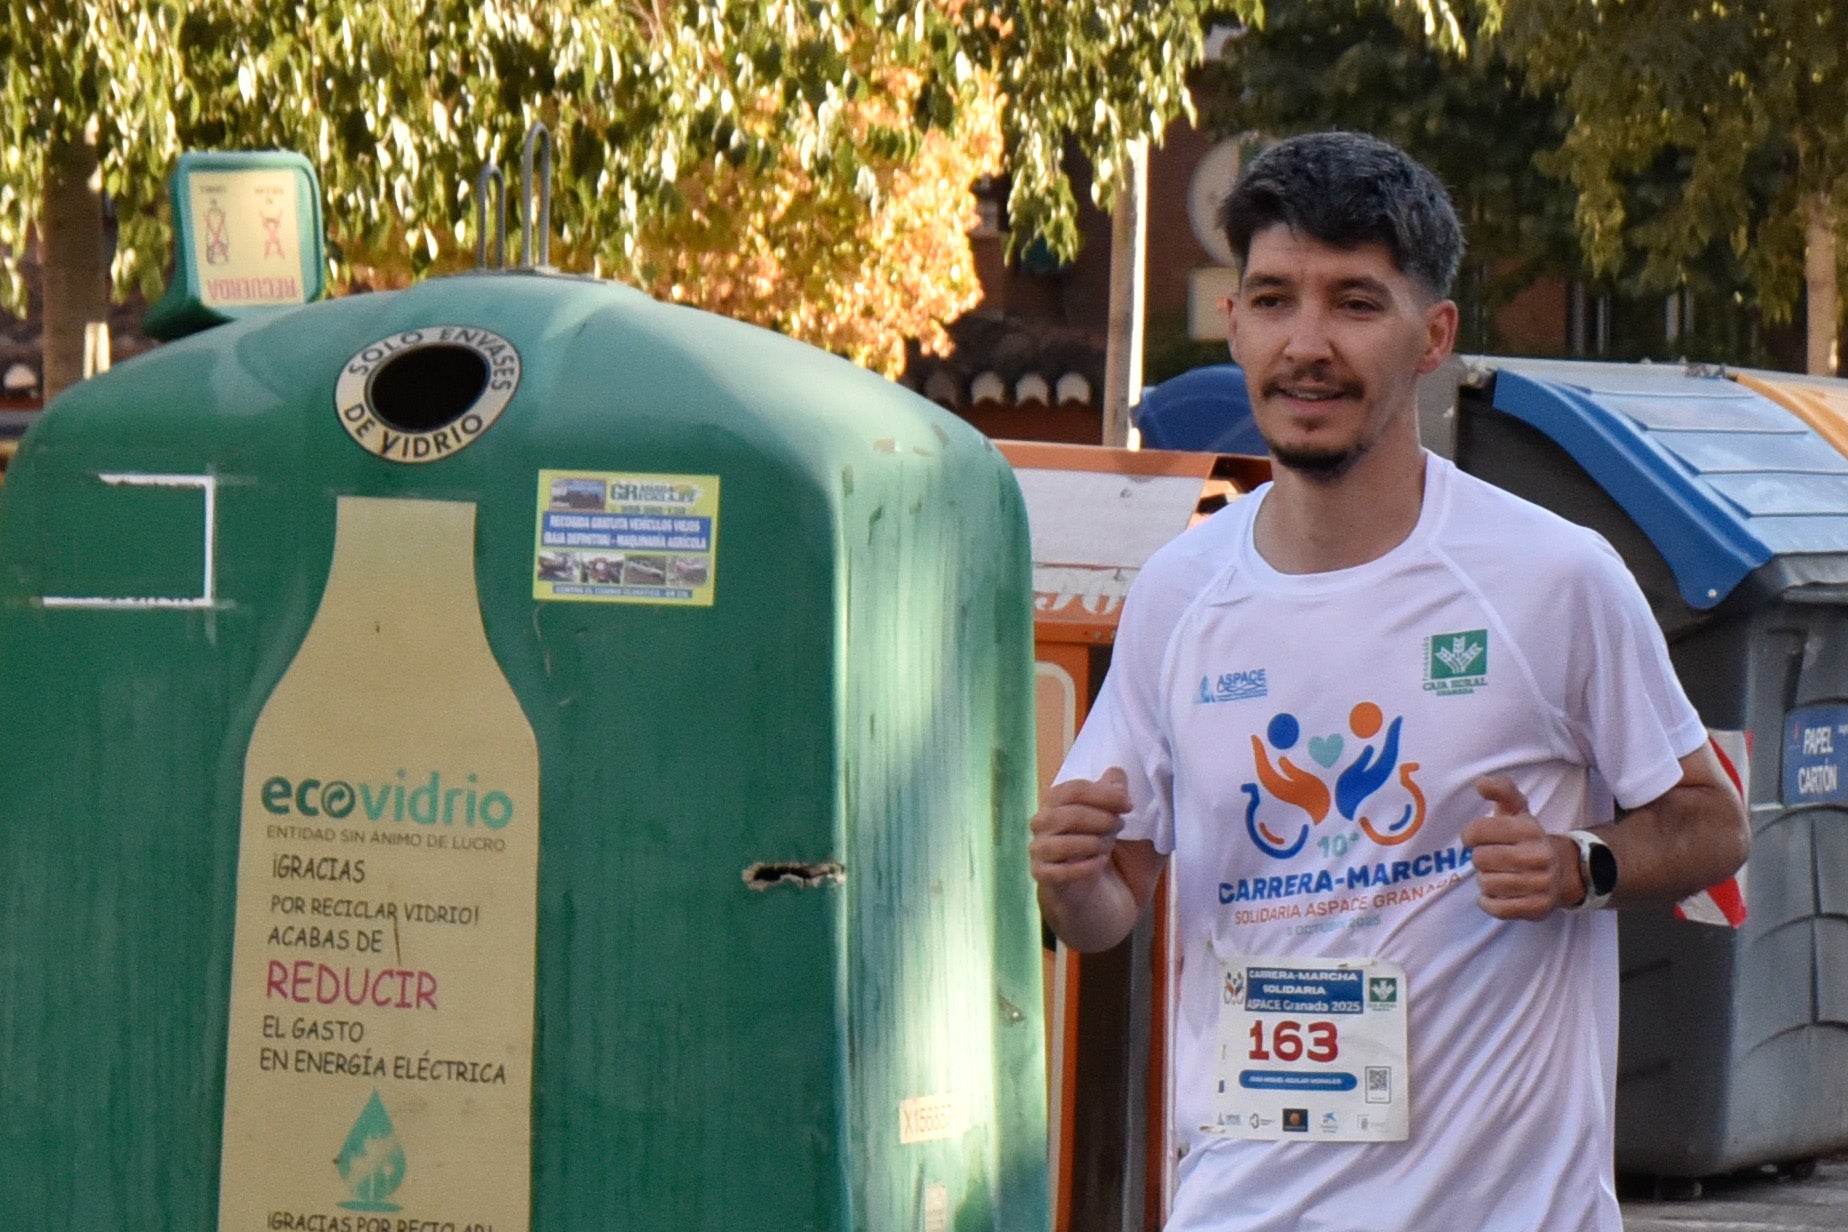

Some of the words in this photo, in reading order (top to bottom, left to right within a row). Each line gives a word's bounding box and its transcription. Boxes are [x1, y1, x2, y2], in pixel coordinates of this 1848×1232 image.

[348, 328, 424, 377] SOLO
[438, 327, 516, 392] ENVASES
[343, 402, 377, 438] DE
[379, 413, 484, 459] VIDRIO
[1216, 668, 1267, 693] ASPACE
[1803, 725, 1834, 755] PAPEL
[1797, 757, 1839, 795] CARTÓN
[261, 768, 515, 831] ecovidrio
[266, 824, 336, 842] ENTIDAD
[340, 830, 366, 844] SIN
[426, 834, 447, 848] DE
[452, 836, 507, 852] LUCRO
[1218, 845, 1474, 904] CARRERA-MARCHA
[270, 894, 305, 915] POR
[310, 896, 398, 920] RECICLAR
[403, 902, 481, 926] VIDRIO!
[1234, 903, 1301, 926] SOLIDARIA
[1304, 895, 1368, 917] ASPACE
[268, 925, 350, 951] ACABAS
[356, 929, 384, 953] DE
[266, 959, 439, 1011] REDUCIR
[1249, 970, 1358, 982] CARRERA-MARCHA
[1282, 1000, 1329, 1012] Granada
[1331, 1001, 1362, 1013] 2025
[262, 1014, 286, 1039] EL
[291, 1016, 365, 1043] GASTO
[1248, 1019, 1339, 1063] 163
[259, 1046, 289, 1071] EN
[293, 1048, 387, 1076] ENERGÍA
[392, 1049, 507, 1085] ELÉCTRICA
